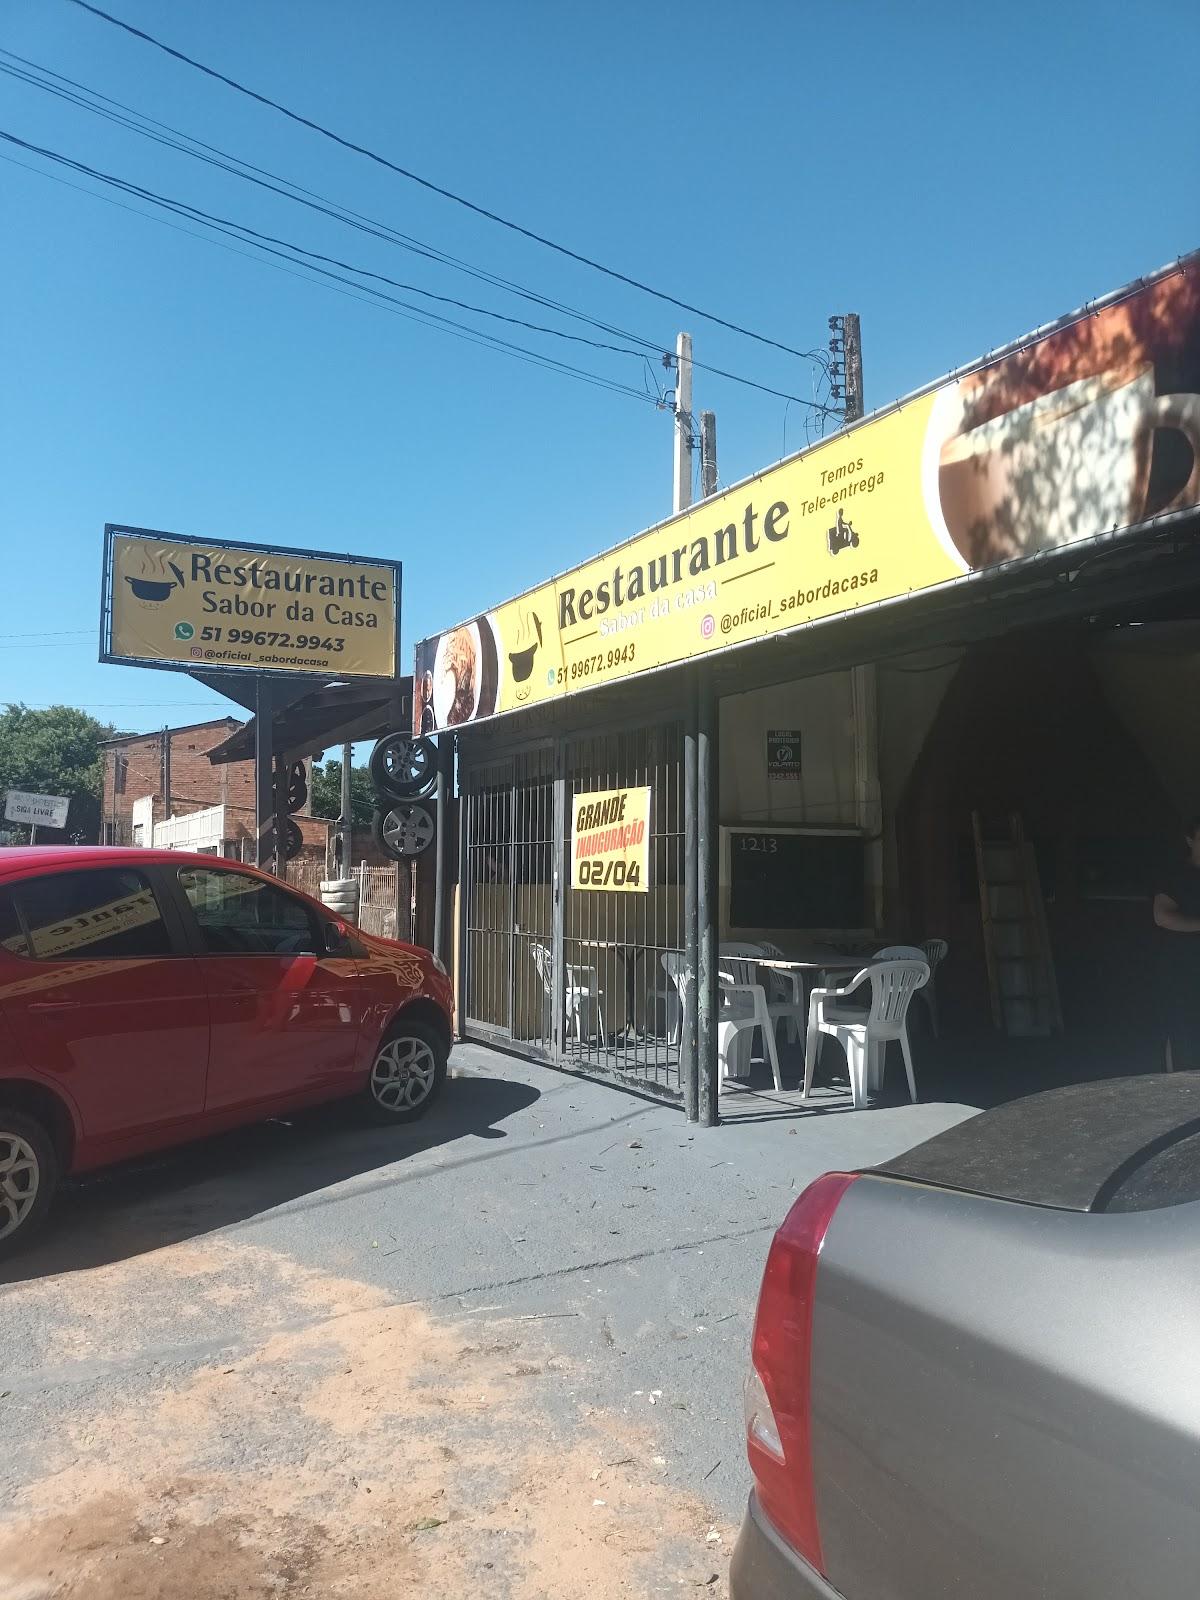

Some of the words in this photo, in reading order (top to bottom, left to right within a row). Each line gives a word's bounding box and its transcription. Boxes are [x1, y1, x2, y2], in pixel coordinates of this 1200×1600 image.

[820, 457, 864, 487] Temos
[801, 471, 885, 517] Tele-entrega
[191, 553, 387, 601] Restaurante
[558, 500, 791, 631] Restaurante
[202, 591, 277, 618] Sabor
[286, 600, 314, 622] da
[324, 603, 378, 628] Casa
[600, 605, 645, 639] Sabor
[650, 597, 670, 618] da
[674, 580, 717, 610] casa
[720, 568, 878, 634] @oficial_sabordacasa
[200, 626, 222, 642] 51
[227, 628, 346, 652] 99672.9943
[556, 665, 569, 684] 51
[571, 642, 636, 680] 99672.9943
[576, 793, 628, 833] GRANDE
[575, 817, 645, 860] INAUGURAÇÃO
[578, 860, 640, 887] 02/04
